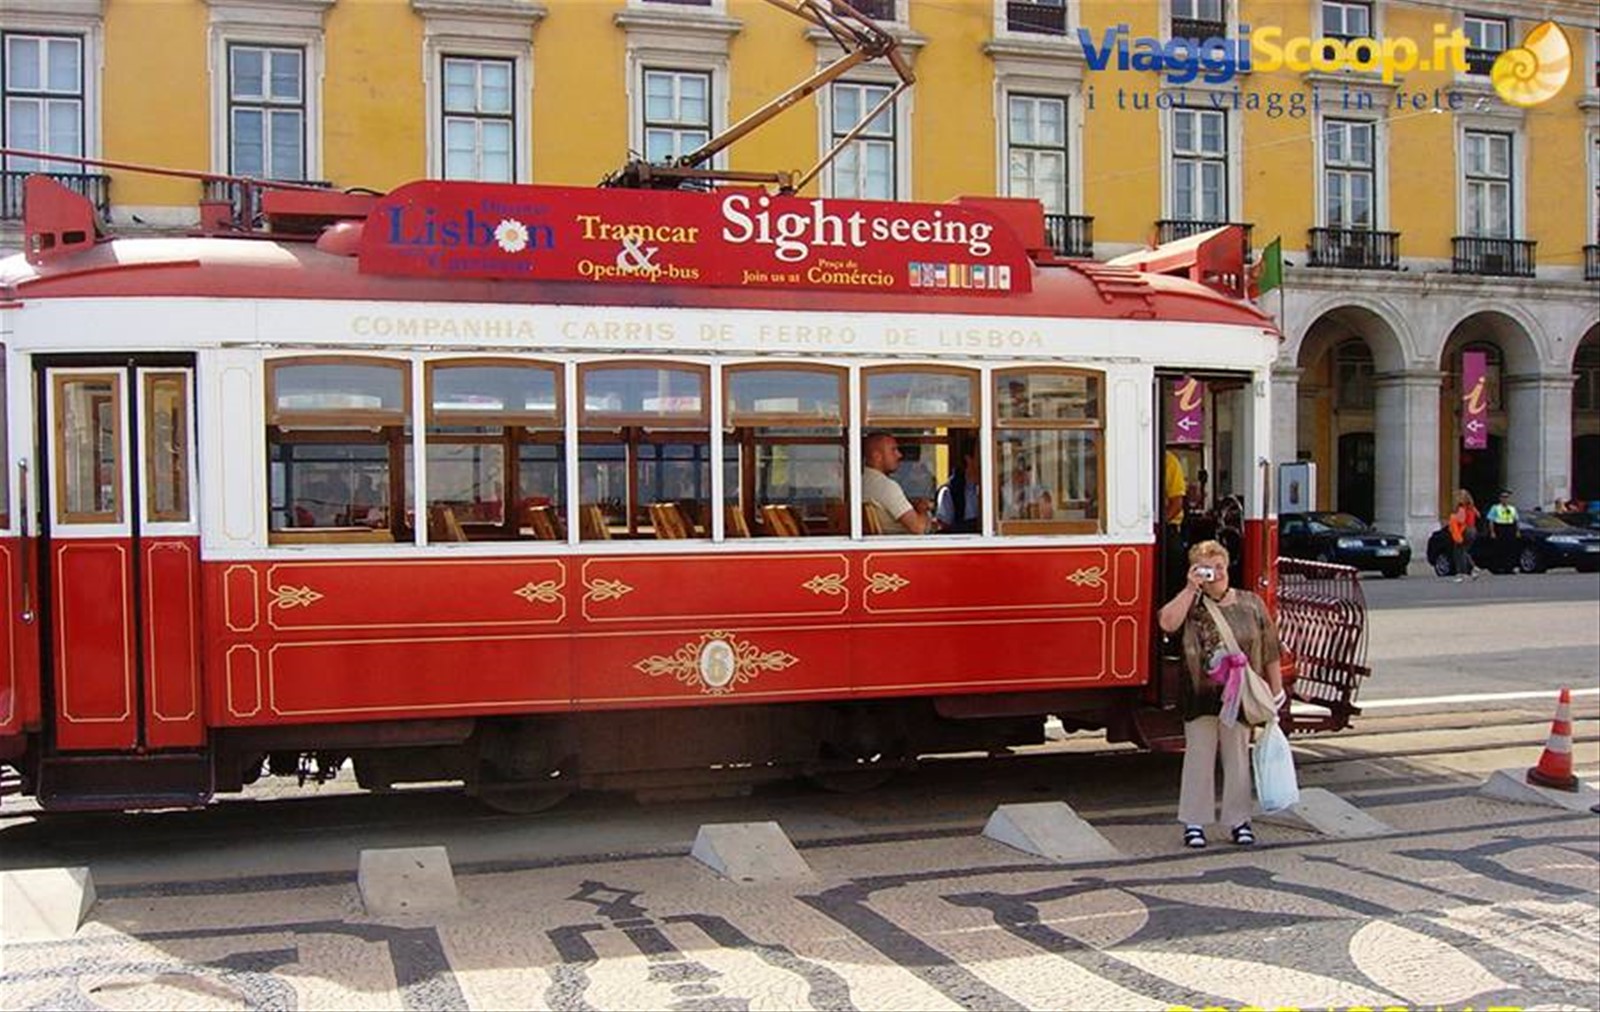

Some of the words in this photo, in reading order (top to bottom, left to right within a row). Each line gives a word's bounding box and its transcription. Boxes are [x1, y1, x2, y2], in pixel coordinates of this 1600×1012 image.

[576, 214, 699, 243] Tramcar
[616, 233, 659, 273] &
[742, 270, 768, 285] Join
[771, 272, 785, 283] us
[807, 266, 895, 286] Comércio
[351, 315, 536, 340] COMPANHIA
[561, 321, 676, 341] CARRIS
[700, 324, 735, 342] DE
[758, 325, 856, 345] FERRO
[886, 328, 918, 346] DE
[938, 330, 1044, 348] LISBOA
